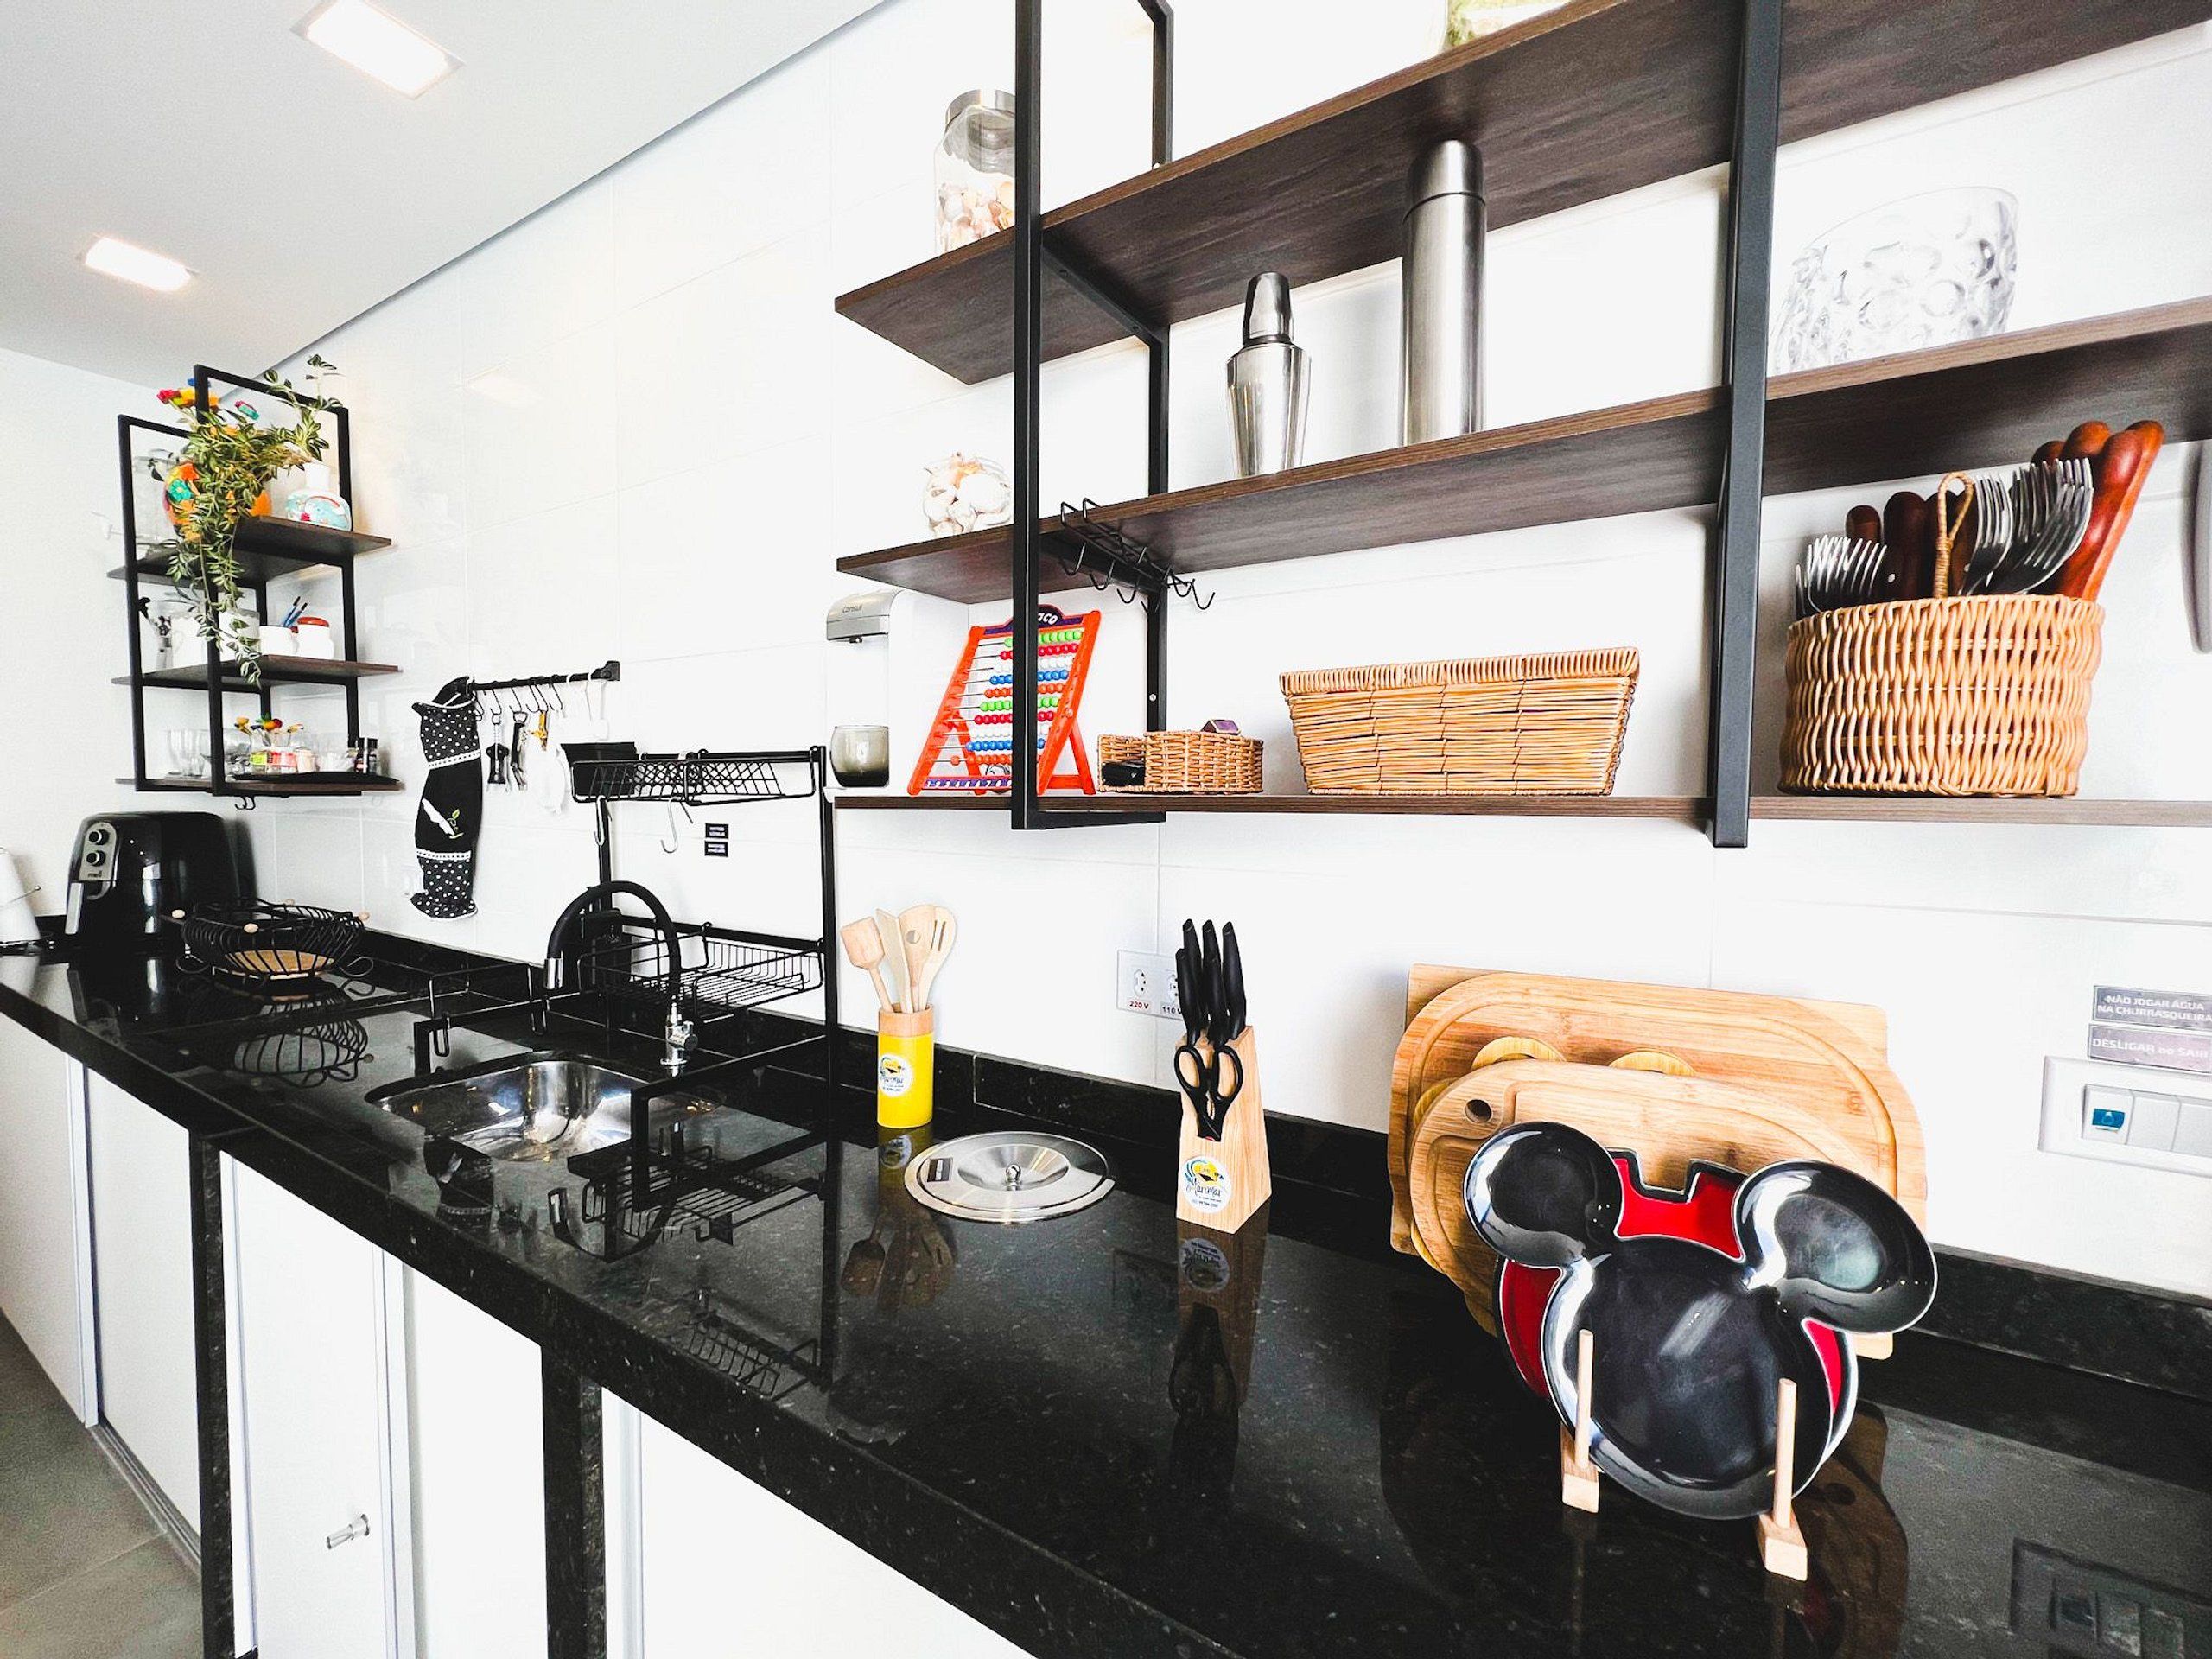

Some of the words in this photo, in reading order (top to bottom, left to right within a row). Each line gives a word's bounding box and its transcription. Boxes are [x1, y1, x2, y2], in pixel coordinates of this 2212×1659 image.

[1129, 1000, 1143, 1009] 220
[2107, 995, 2131, 1005] NÃO
[2133, 998, 2170, 1007] JOGAR
[2097, 1004, 2114, 1014] NA
[2116, 1007, 2212, 1021] CHURRASQUEIRA
[2092, 1039, 2155, 1052] DESLIGAR
